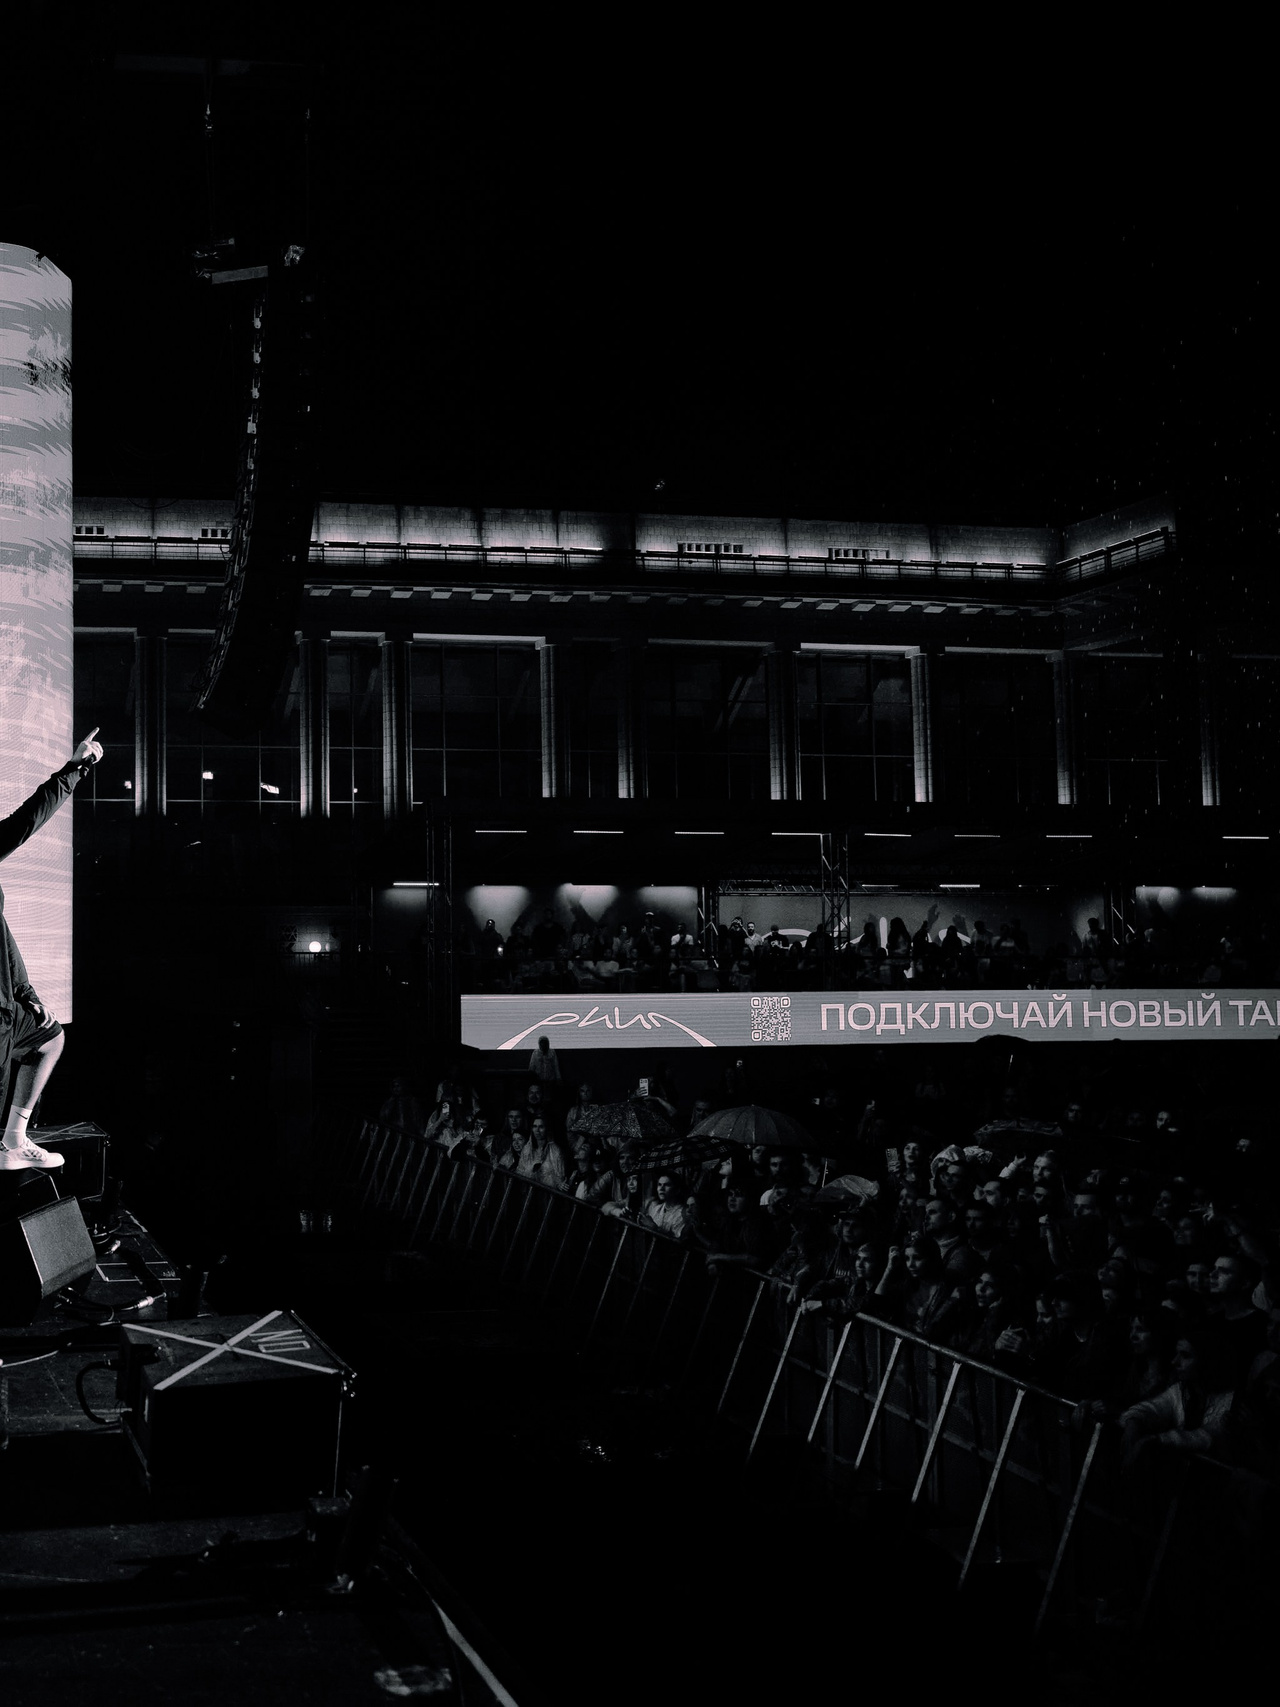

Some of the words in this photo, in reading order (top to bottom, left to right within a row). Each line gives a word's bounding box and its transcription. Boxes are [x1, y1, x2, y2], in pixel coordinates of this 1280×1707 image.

[820, 993, 1073, 1036] ПОДКЛЮЧАЙ
[1083, 992, 1222, 1028] НОВЫЙ
[1228, 1000, 1280, 1026] ТА
